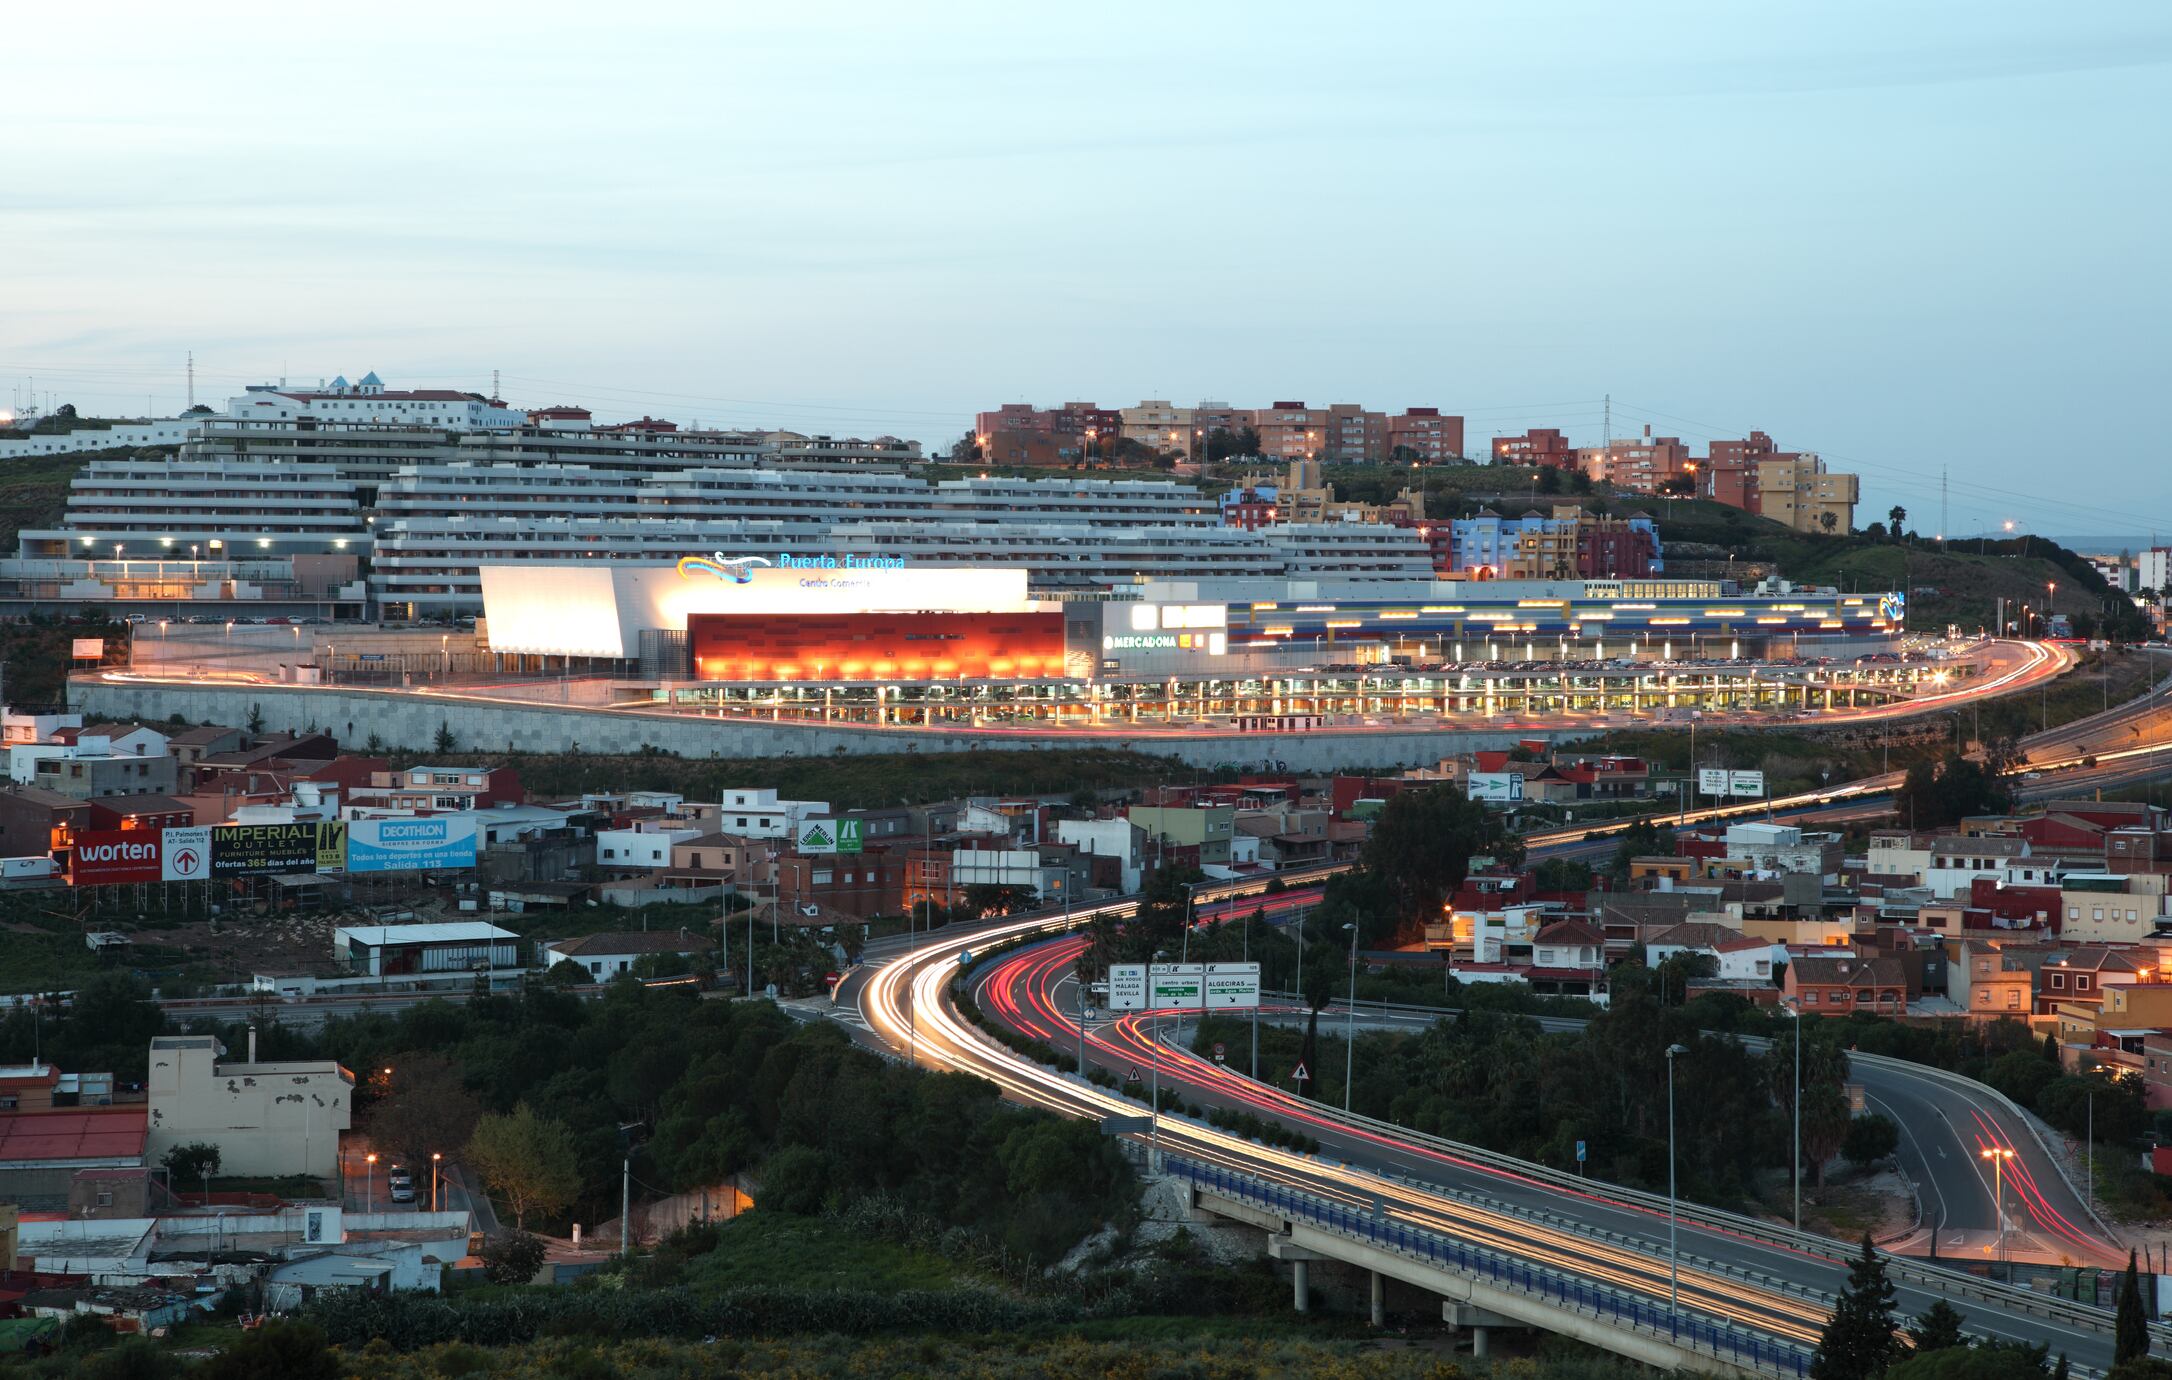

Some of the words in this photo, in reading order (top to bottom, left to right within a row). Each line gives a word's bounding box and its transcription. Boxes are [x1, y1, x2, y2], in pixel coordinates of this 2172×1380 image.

[780, 553, 835, 569] Puerta
[846, 553, 905, 573] Europa
[800, 578, 828, 588] Centro
[1114, 636, 1176, 648] MERCADONA
[215, 825, 315, 841] IMPERIAL
[382, 824, 444, 838] DECATHLON
[800, 828, 817, 845] LEROY
[814, 824, 835, 845] MERLIN
[233, 840, 296, 849] OUTLET
[80, 841, 156, 862] worten
[220, 850, 265, 858] FURNITURE
[352, 853, 374, 861] Todos
[389, 852, 423, 861] deportes
[215, 859, 246, 868] Ofertas
[247, 858, 266, 868] 365
[286, 858, 298, 866] del
[384, 861, 418, 870] Salida
